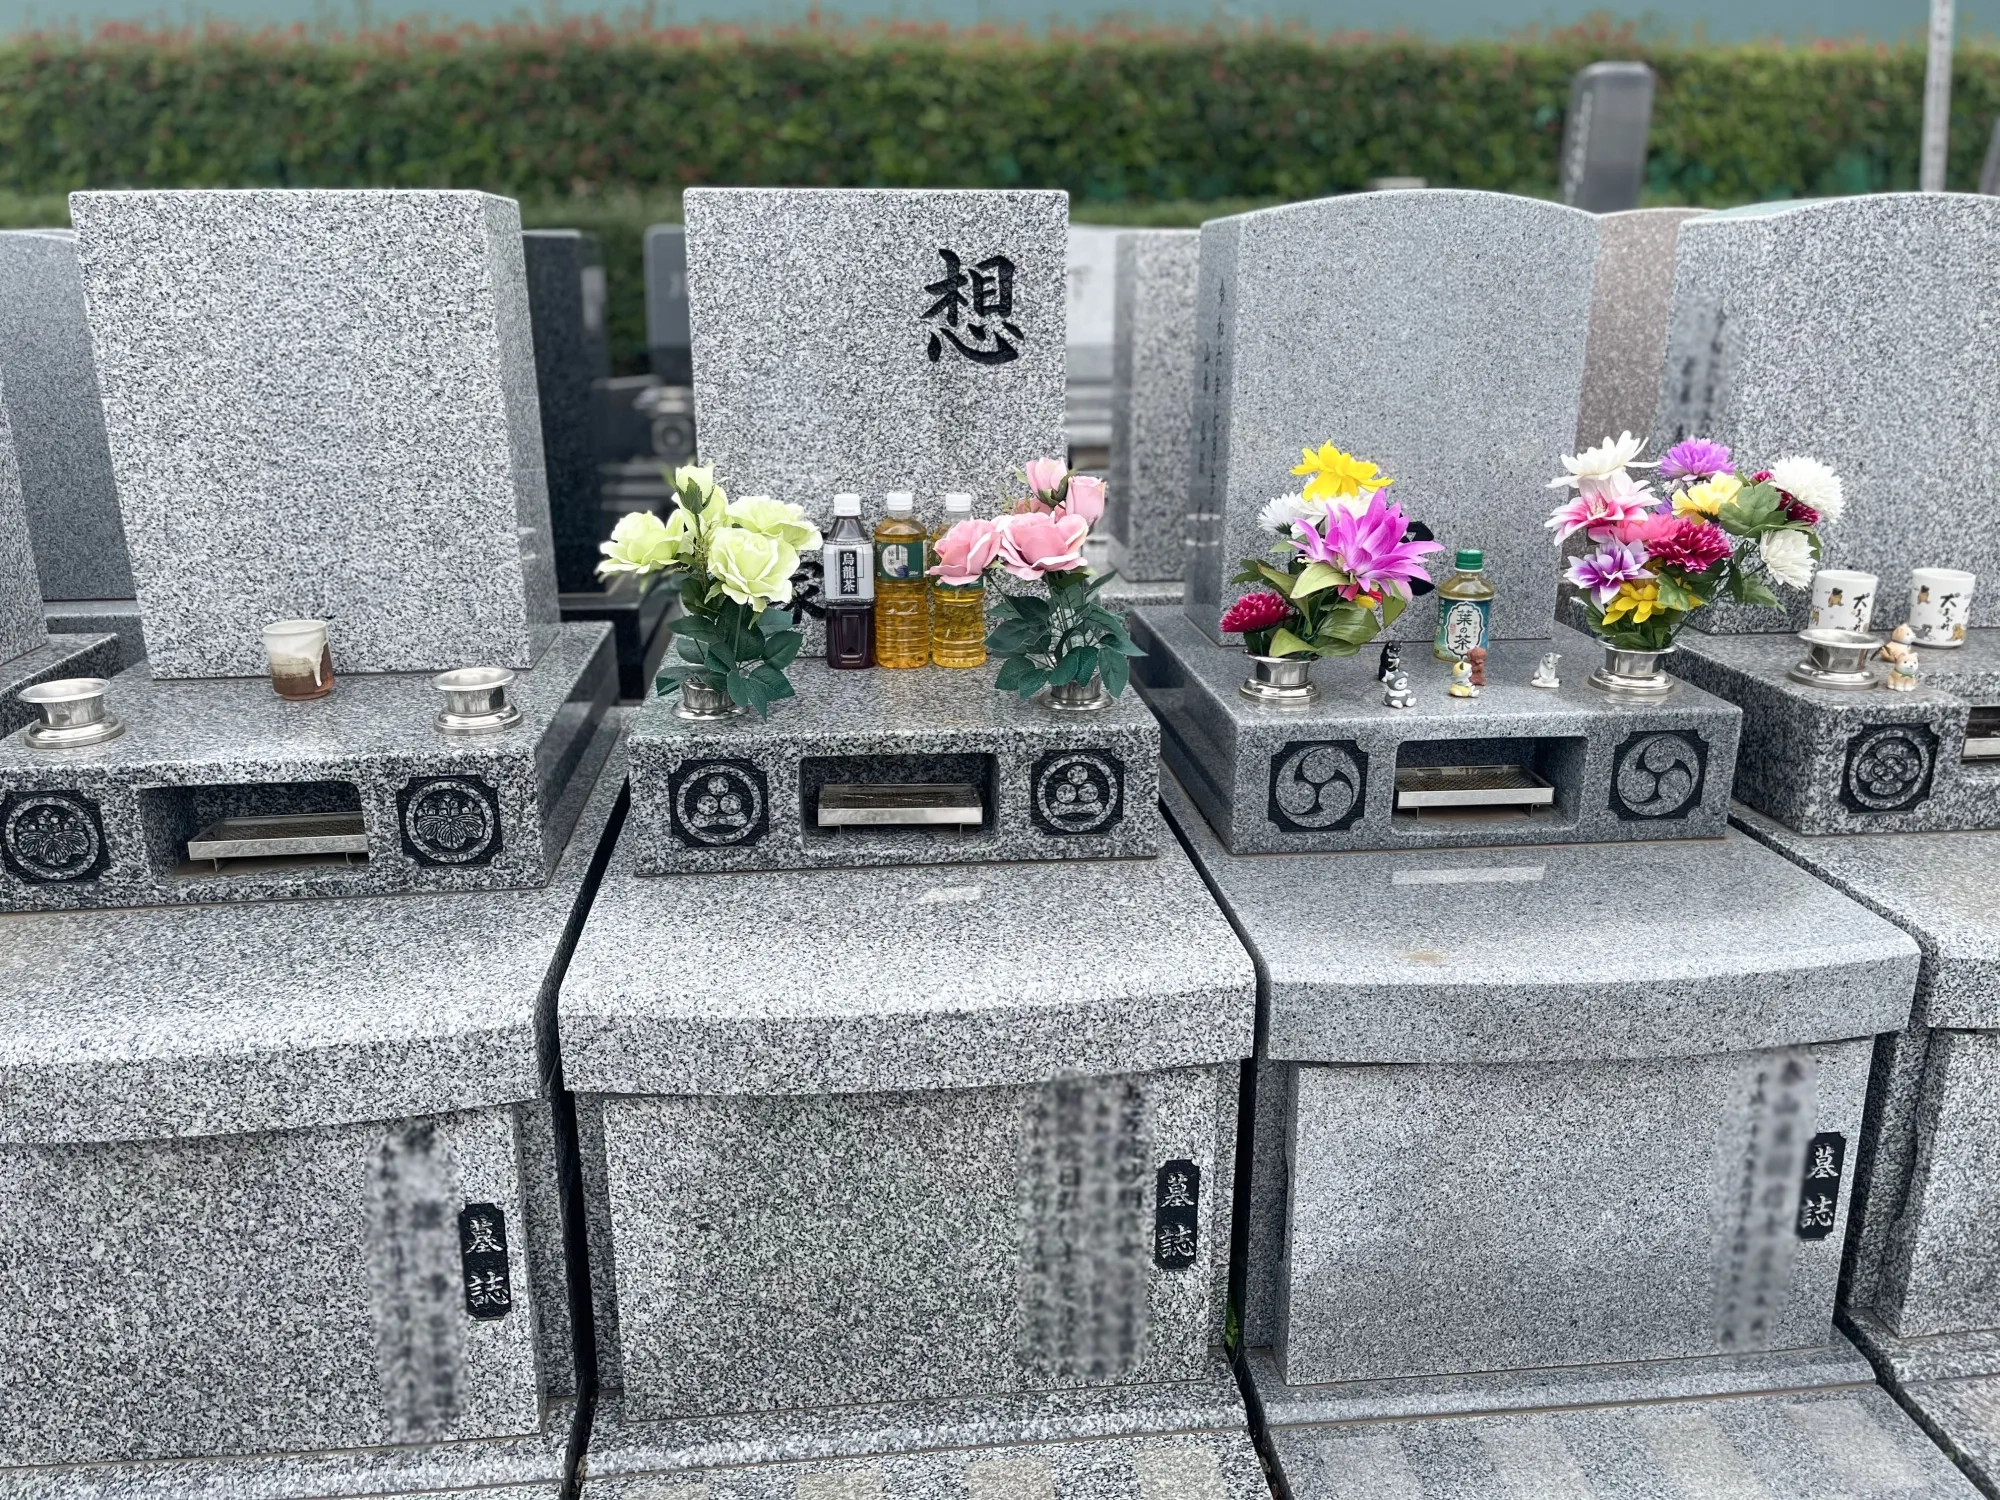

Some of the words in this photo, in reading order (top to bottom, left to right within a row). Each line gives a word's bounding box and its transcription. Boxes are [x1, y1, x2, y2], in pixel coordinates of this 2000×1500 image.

[919, 249, 1024, 365] 想
[842, 552, 856, 593] 烏龍茶
[1454, 609, 1473, 651] 葉の茶
[1158, 1172, 1195, 1259] 墓誌
[1800, 1144, 1839, 1230] 墓誌
[465, 1217, 510, 1309] 墓誌
